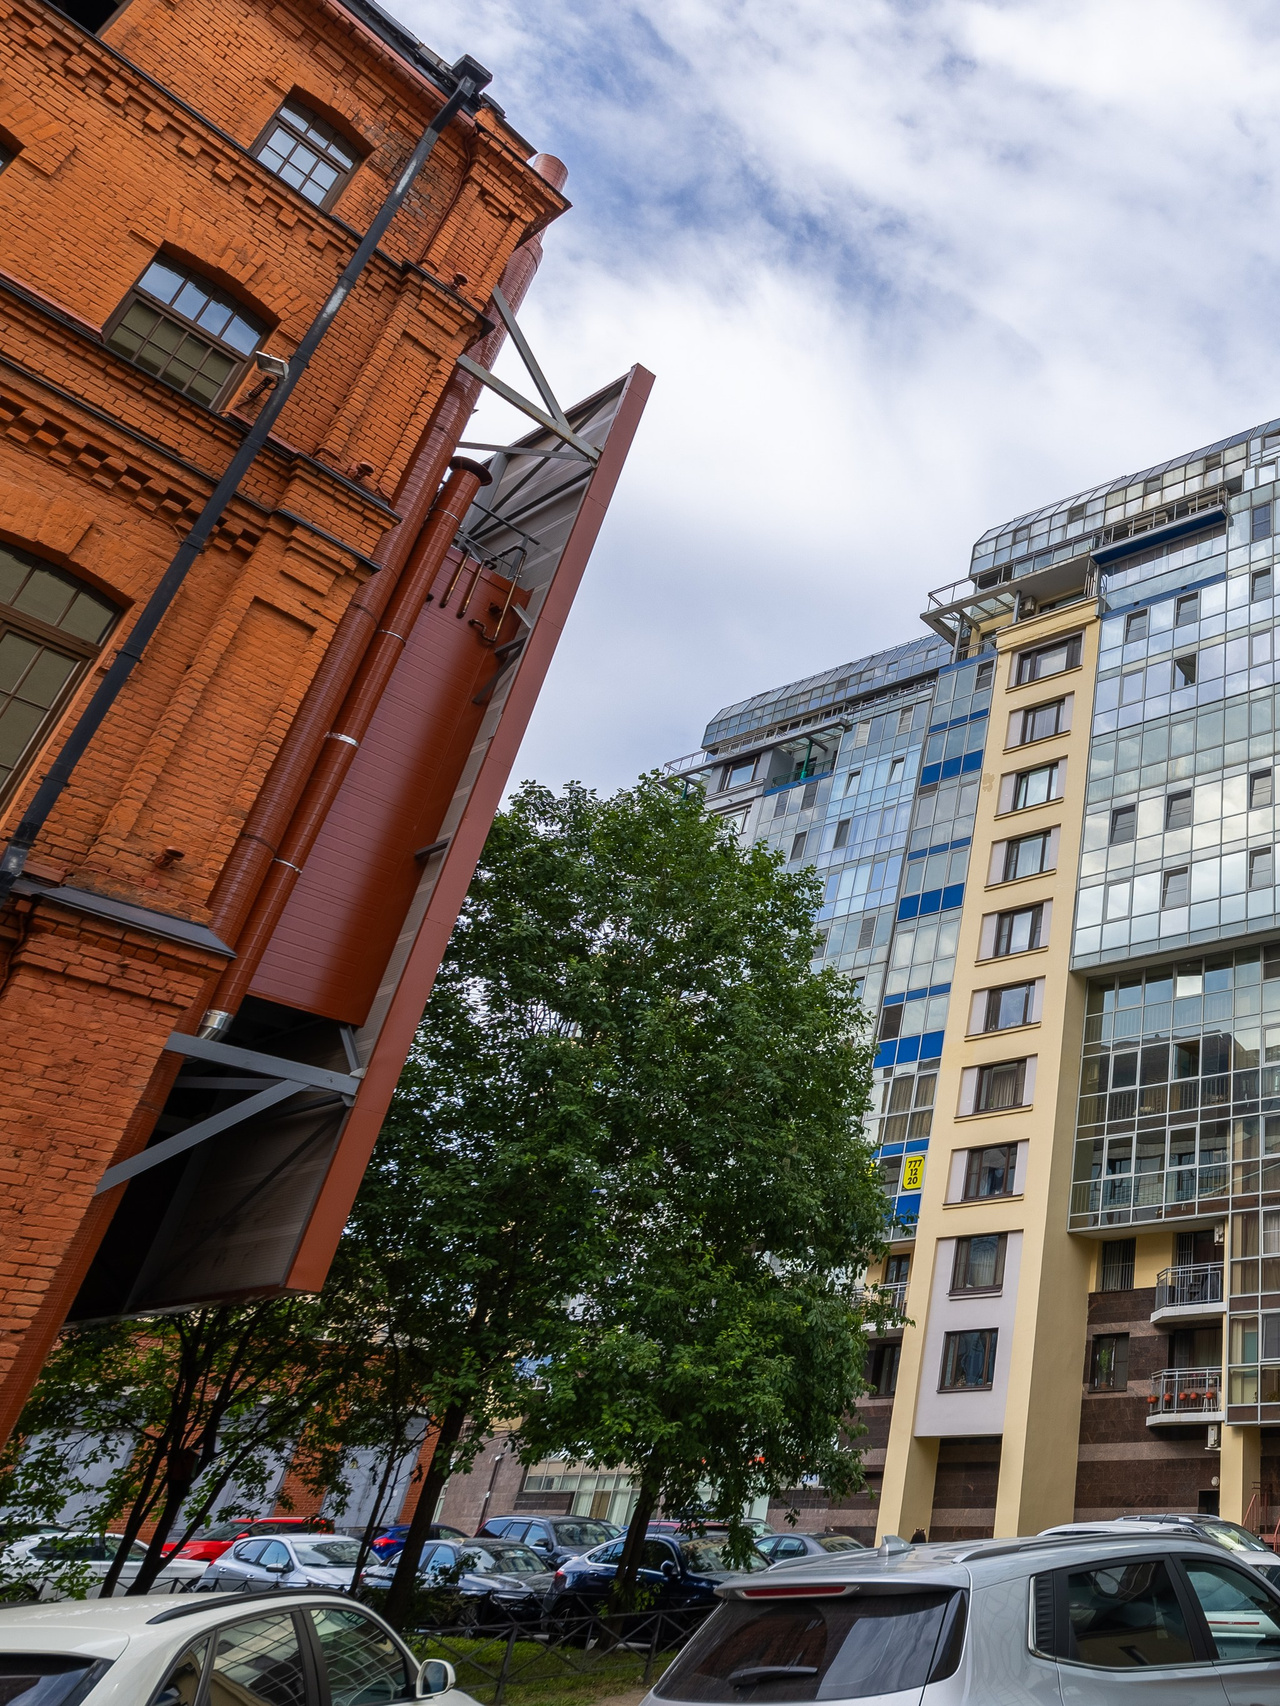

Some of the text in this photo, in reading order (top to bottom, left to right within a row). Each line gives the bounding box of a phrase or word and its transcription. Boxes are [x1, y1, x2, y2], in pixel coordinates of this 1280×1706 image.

[908, 1160, 922, 1168] 777
[910, 1168, 918, 1176] 12
[907, 1177, 918, 1185] 20
